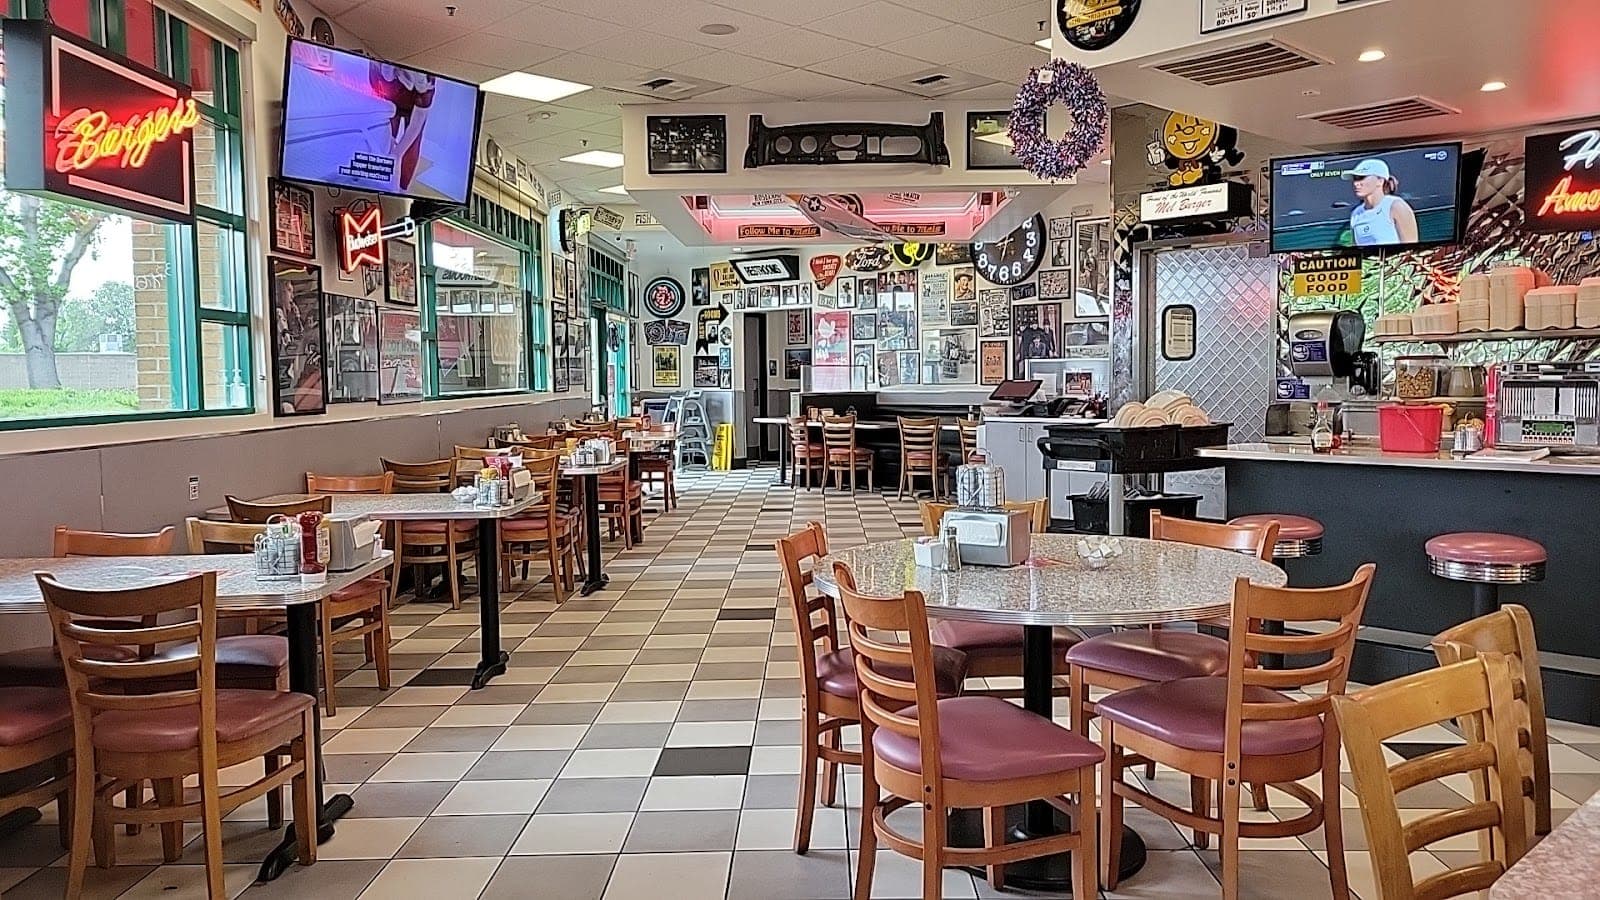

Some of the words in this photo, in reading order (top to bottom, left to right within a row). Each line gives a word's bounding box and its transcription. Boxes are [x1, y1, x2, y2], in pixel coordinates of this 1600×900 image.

[62, 98, 200, 170] Burgers
[1155, 201, 1177, 214] Mel
[1179, 199, 1213, 212] Burger
[741, 226, 766, 235] Follow
[768, 226, 780, 235] Me
[782, 227, 791, 235] to
[907, 225, 915, 233] to
[347, 229, 380, 252] Budweiser
[1026, 232, 1036, 247] 3
[853, 250, 881, 267] Ford
[978, 253, 988, 268] 8
[1023, 248, 1034, 262] 4
[1300, 257, 1357, 271] CAUTION
[988, 264, 997, 280] 7
[999, 265, 1009, 281] 6
[1306, 272, 1349, 283] GOOD
[1307, 283, 1348, 293] FOOD
